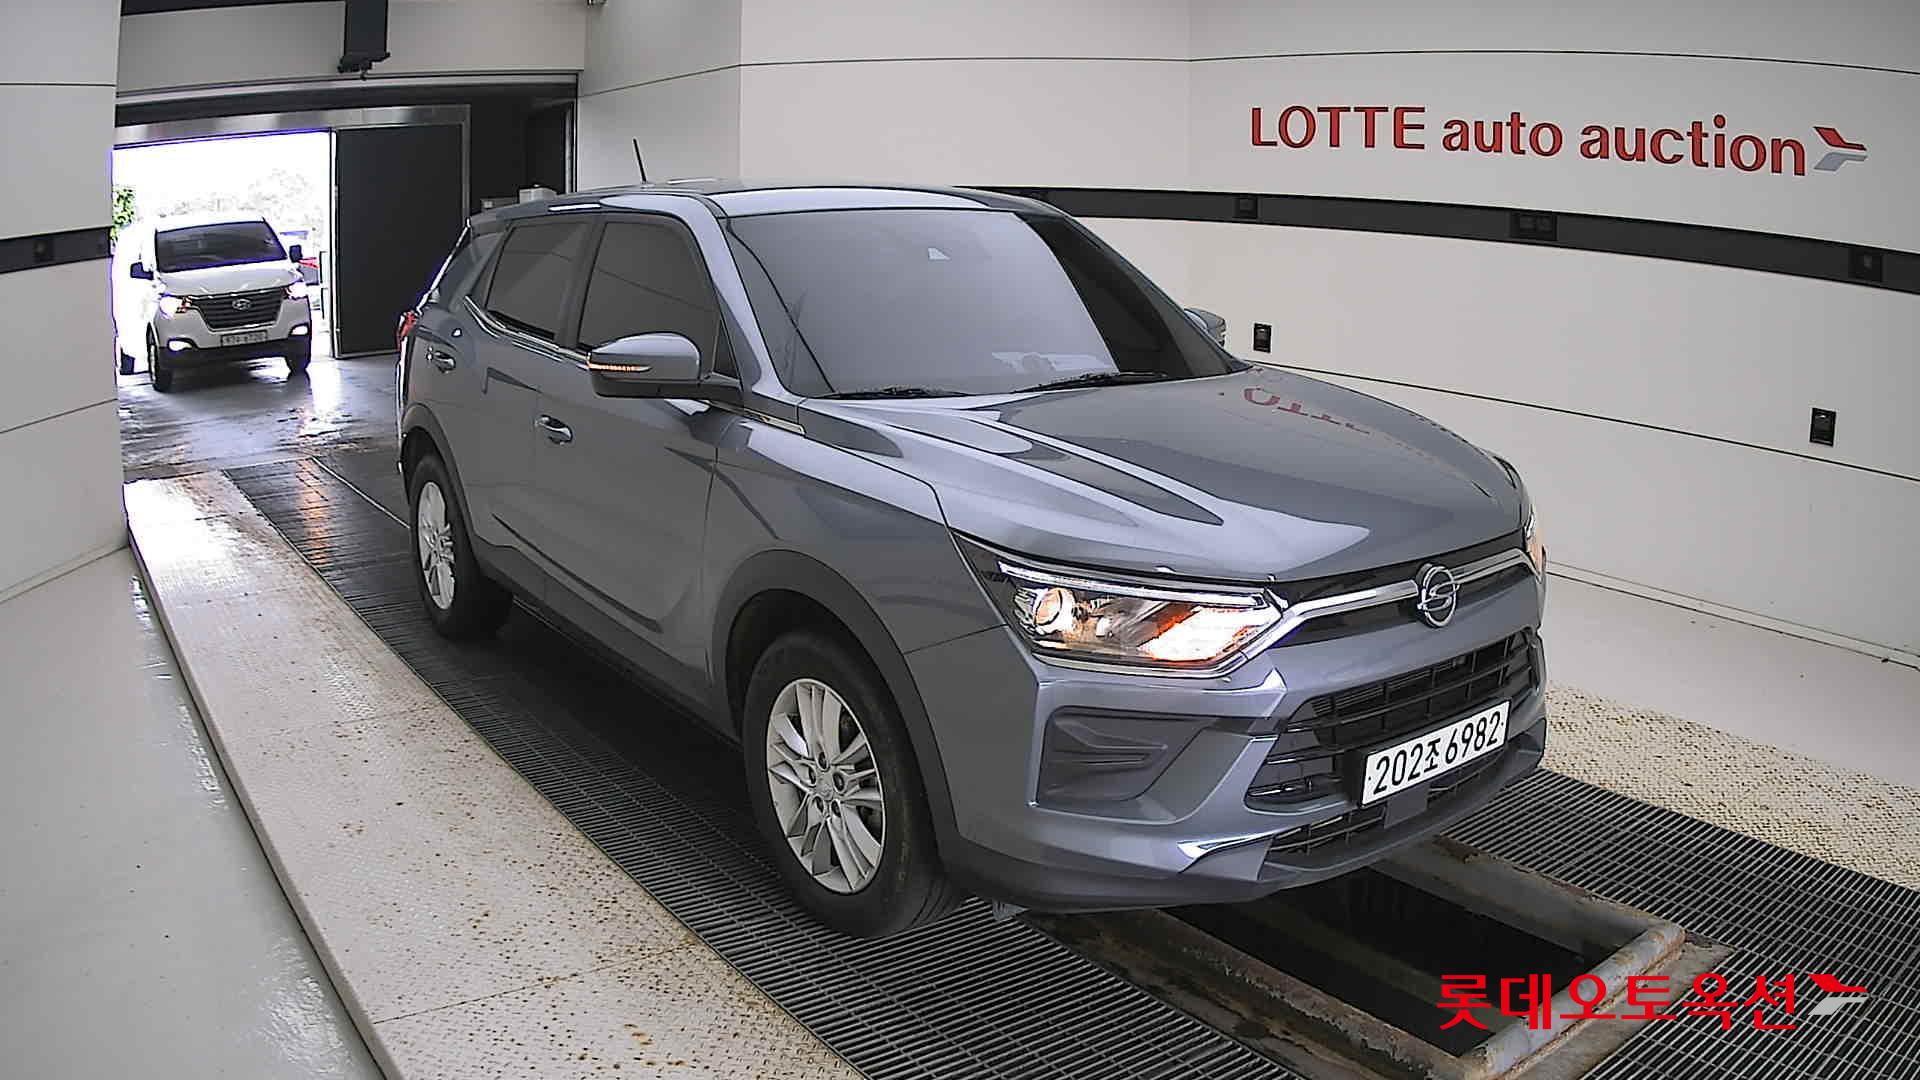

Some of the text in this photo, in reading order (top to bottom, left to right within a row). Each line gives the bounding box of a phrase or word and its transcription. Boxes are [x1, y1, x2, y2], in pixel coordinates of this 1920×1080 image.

[1250, 105, 1807, 176] LOTTE auto auction
